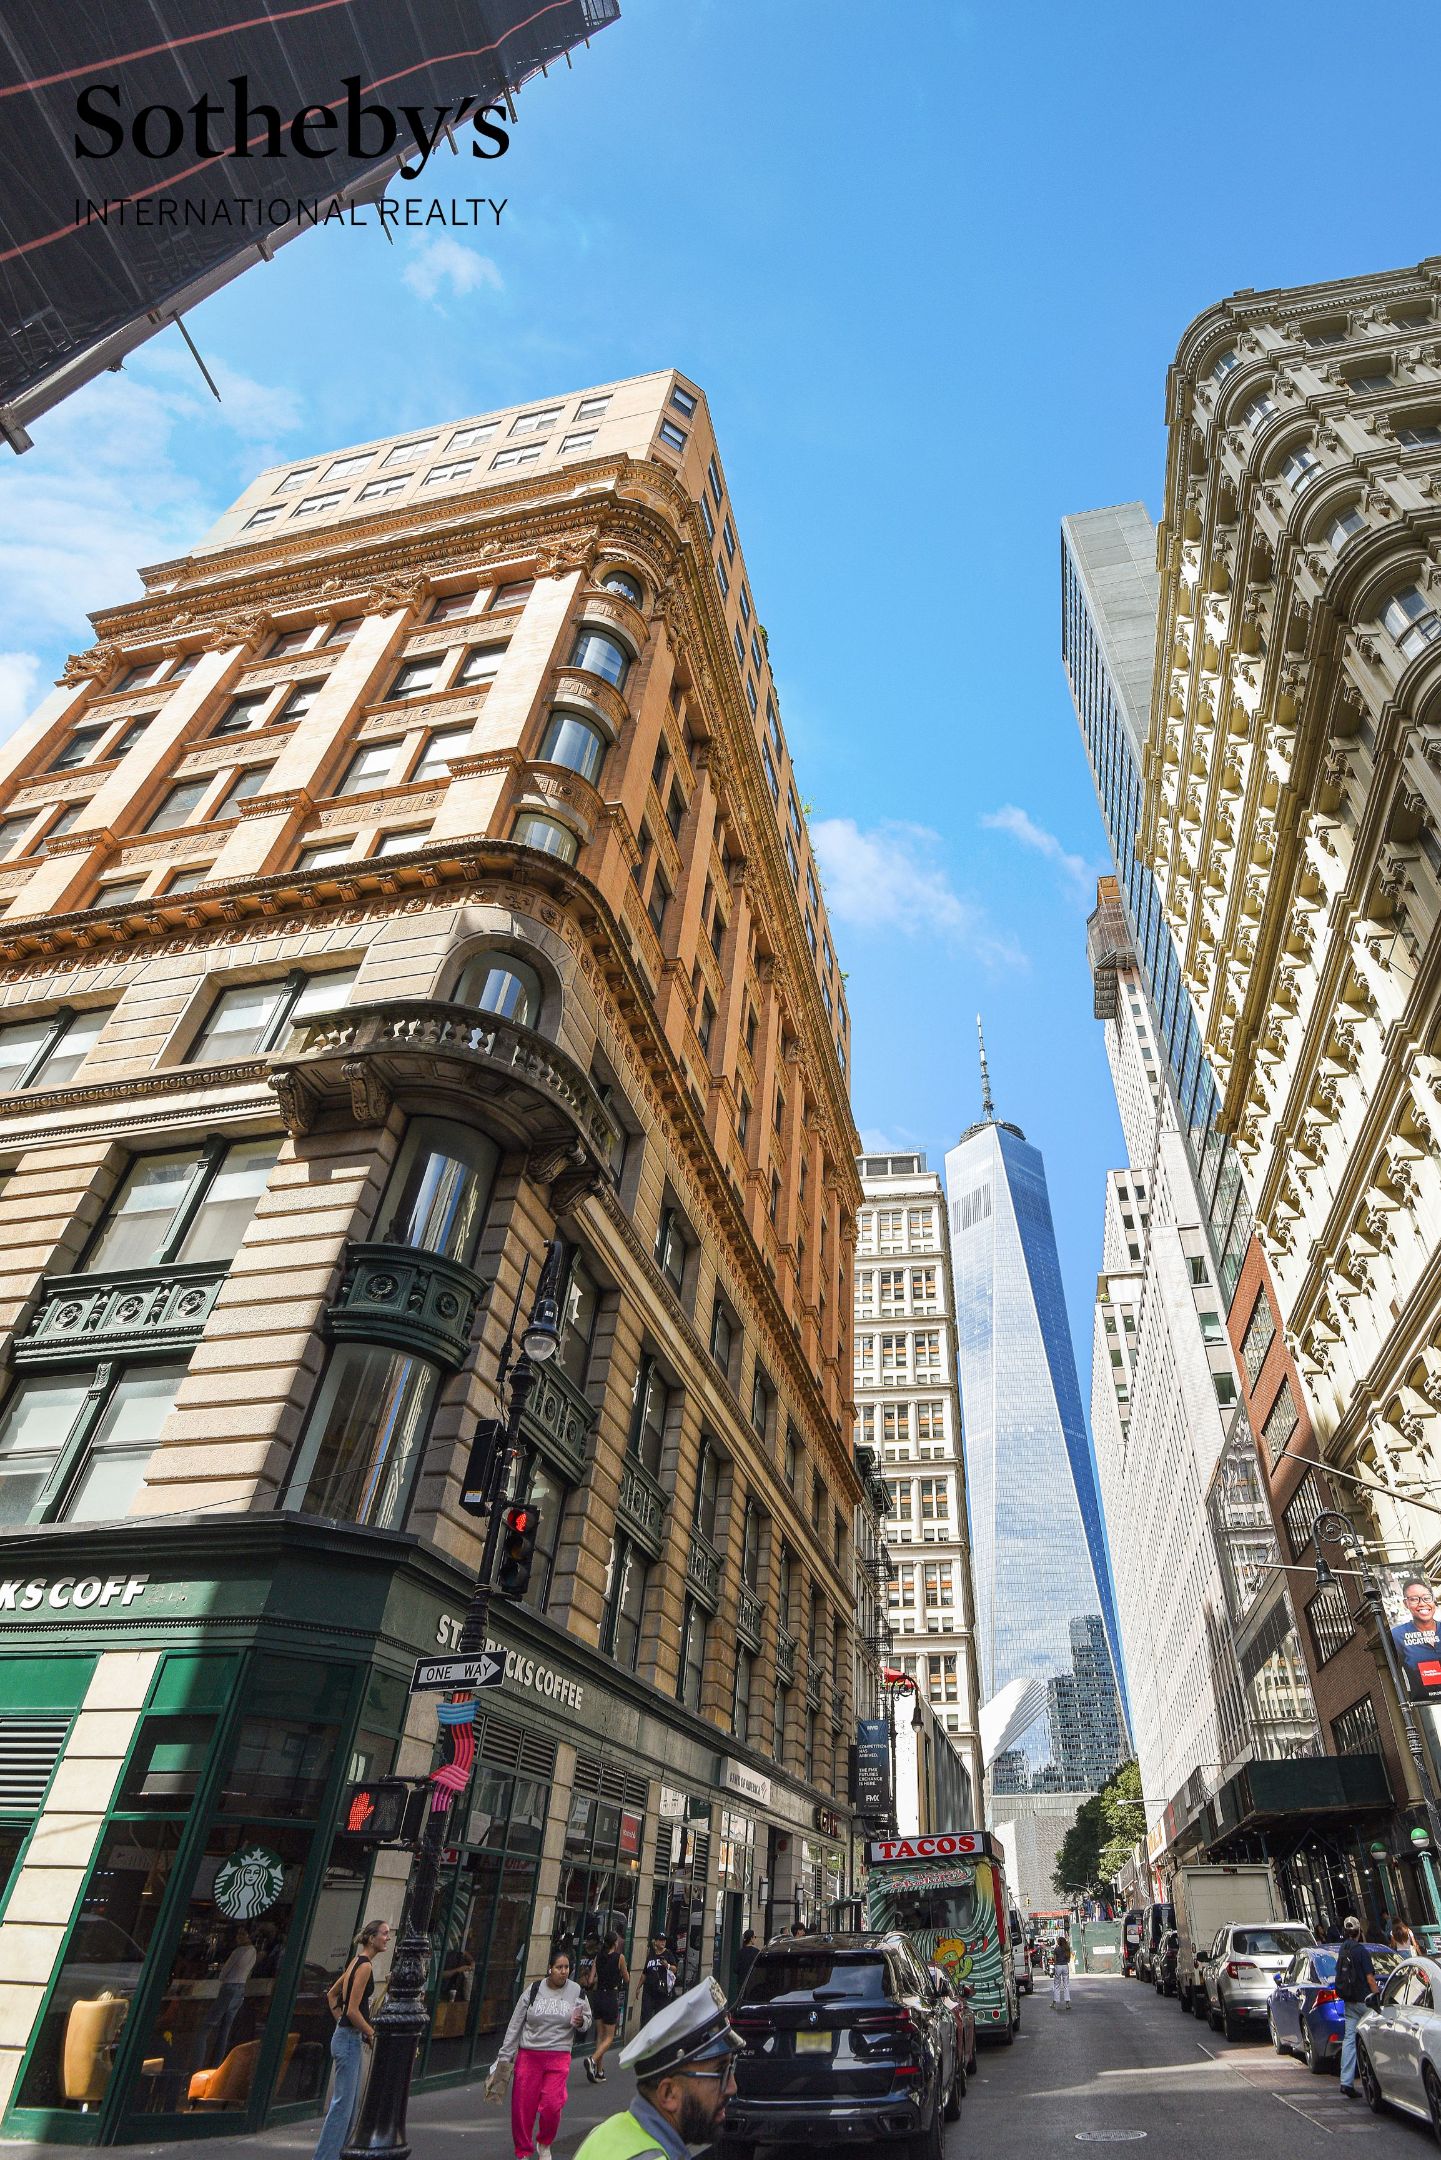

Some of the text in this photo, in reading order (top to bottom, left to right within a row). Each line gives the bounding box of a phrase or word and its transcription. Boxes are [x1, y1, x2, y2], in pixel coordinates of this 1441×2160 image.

[50, 1574, 150, 1609] COFF
[1403, 1635, 1440, 1647] LOCATIONS
[1404, 1631, 1423, 1640] OVER
[426, 1662, 492, 1681] ONE WAY
[535, 1666, 584, 1711] COFFEE
[865, 1794, 880, 1802] FMX
[878, 1835, 976, 1859] TACOS
[534, 1998, 571, 2017] GAP
